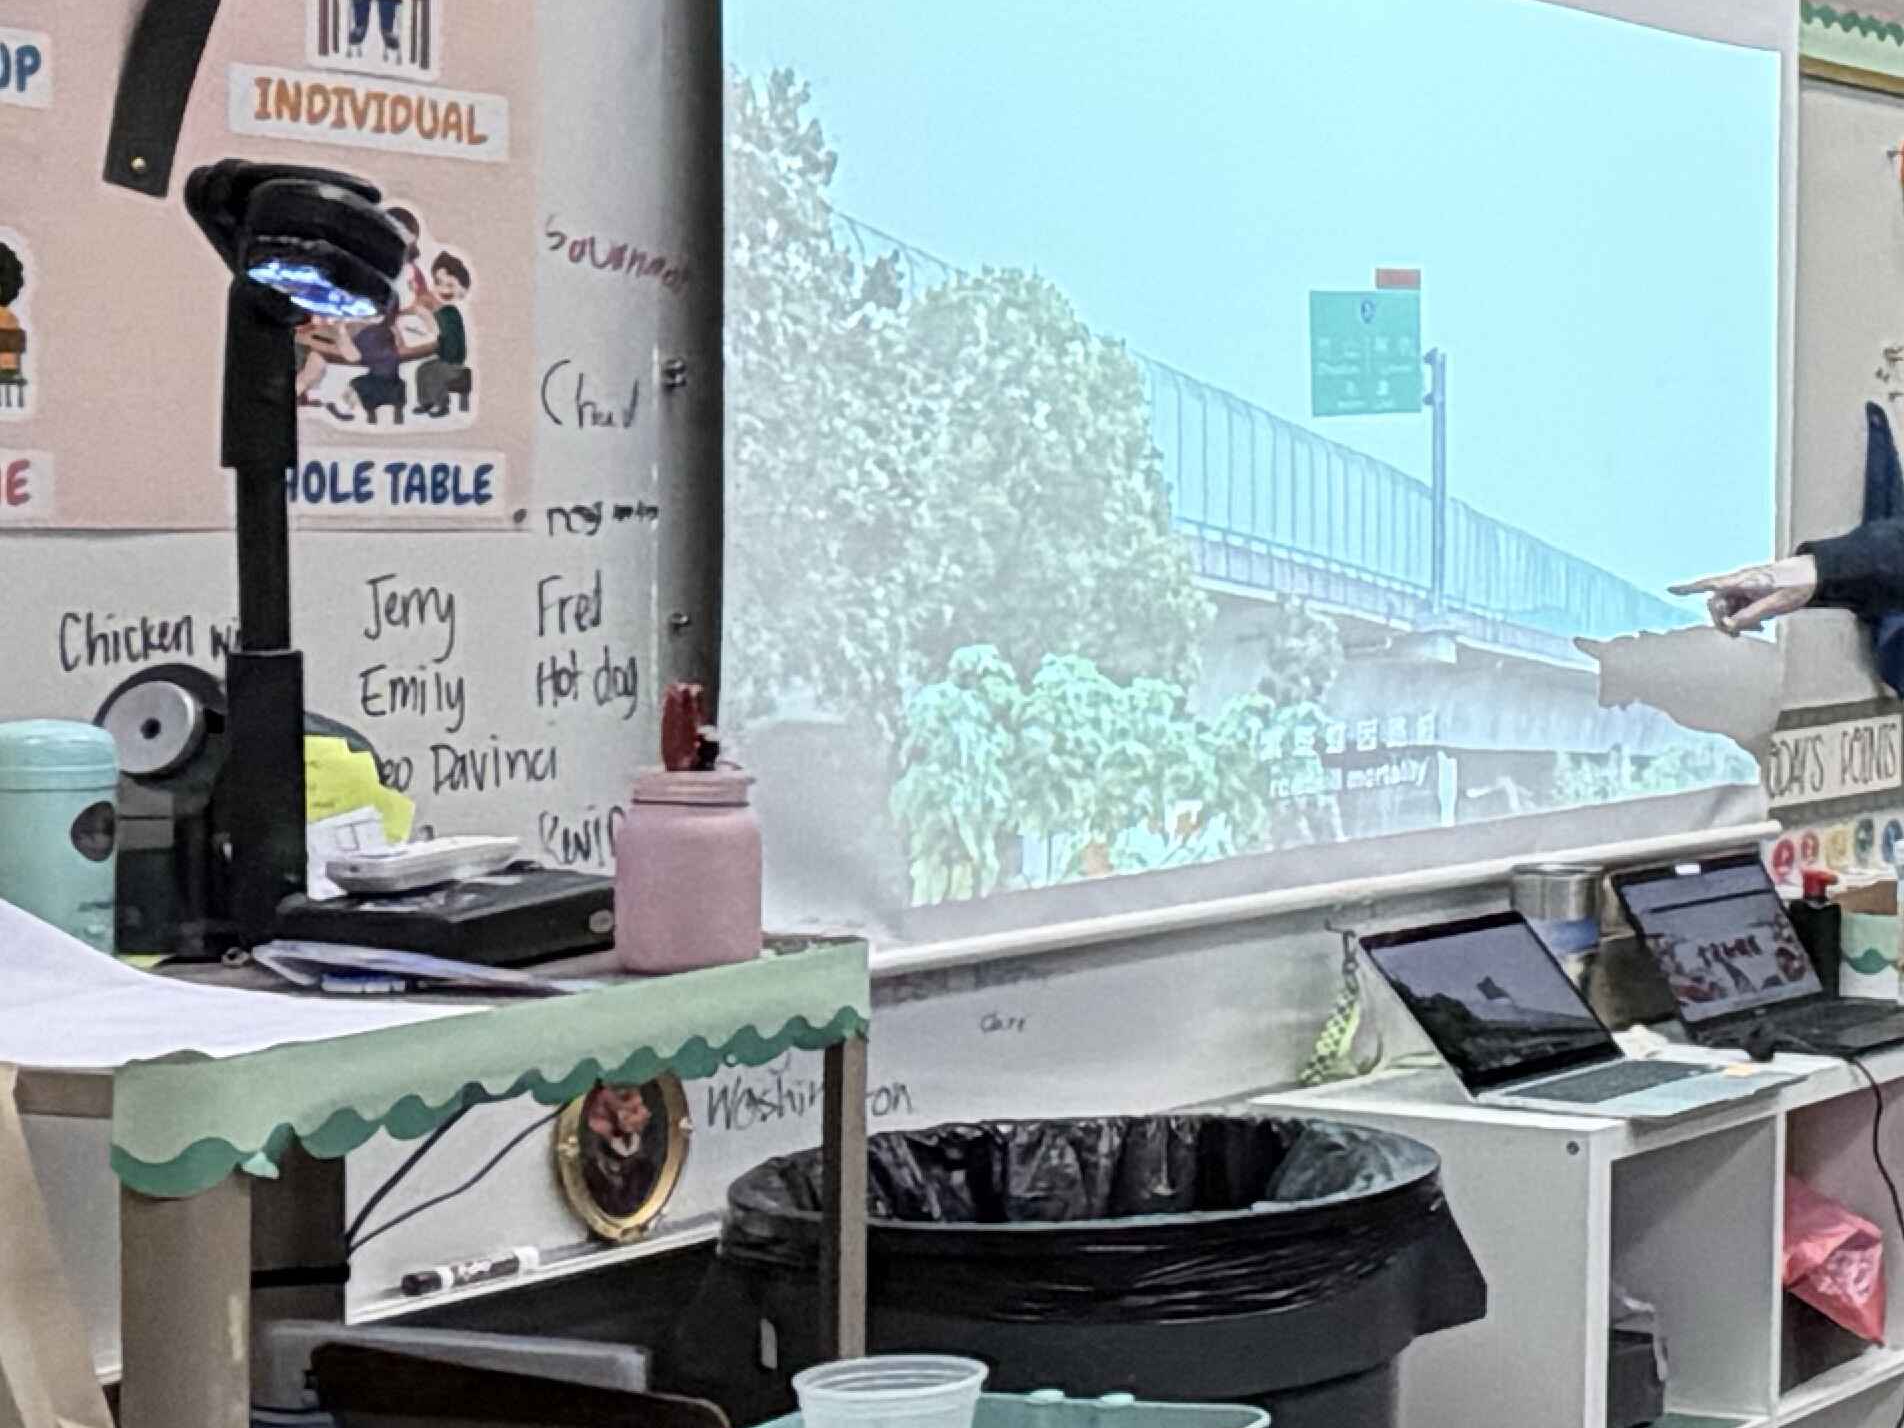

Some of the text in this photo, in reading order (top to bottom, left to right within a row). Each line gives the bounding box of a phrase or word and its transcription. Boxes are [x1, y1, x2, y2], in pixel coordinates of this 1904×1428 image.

[253, 77, 489, 146] INDIVIDUAL
[284, 461, 494, 506] HOLE TABLE
[59, 611, 194, 672] Chicken
[364, 570, 603, 664] Jerry Fred
[360, 663, 465, 734] Emily
[538, 649, 583, 708] Hot
